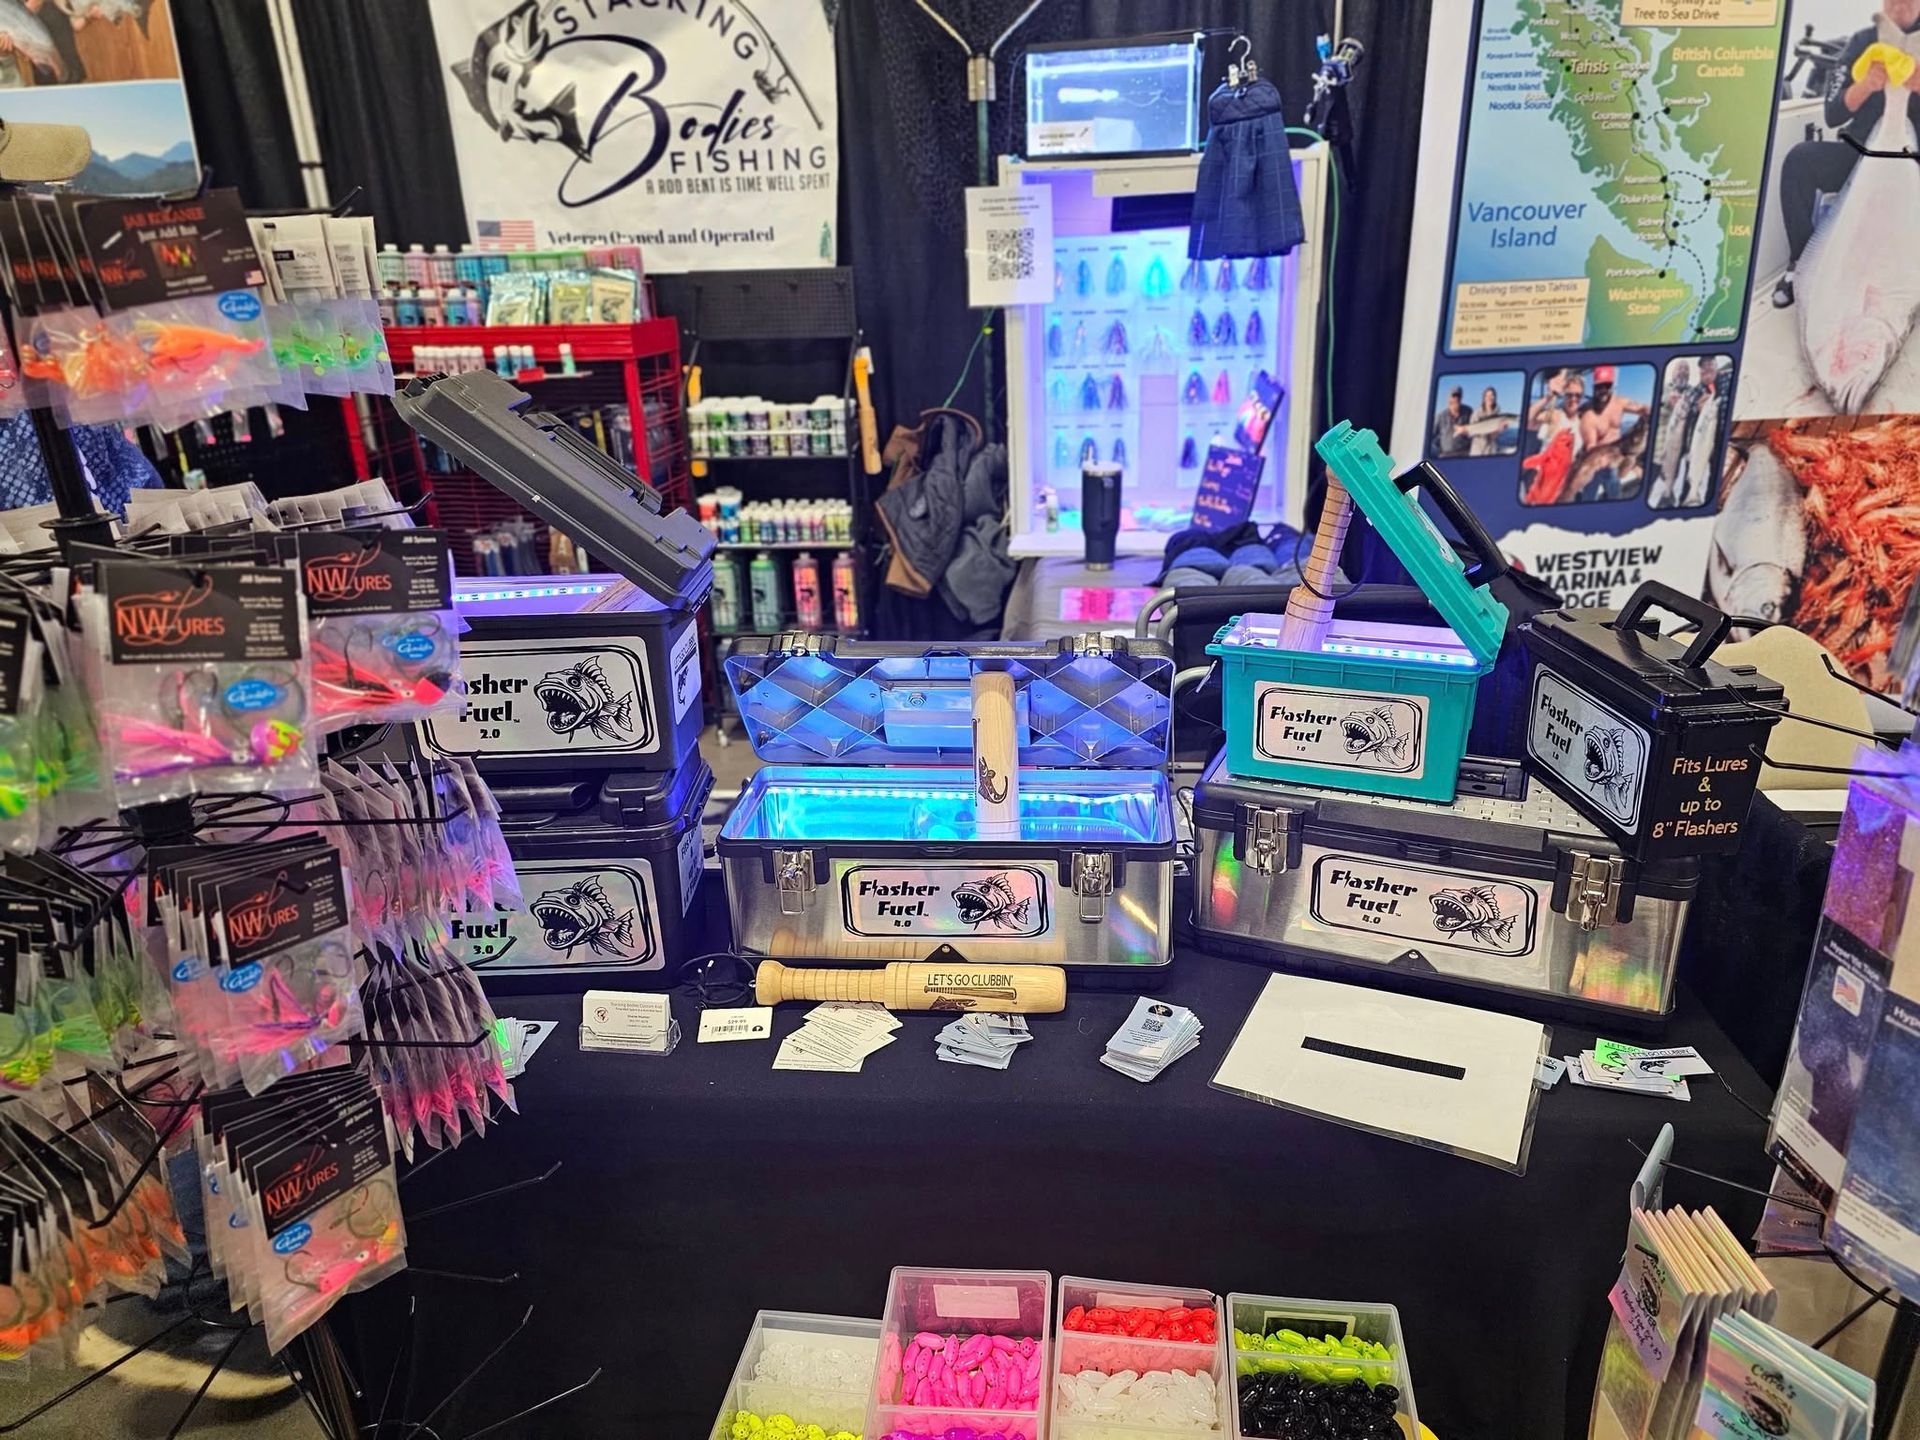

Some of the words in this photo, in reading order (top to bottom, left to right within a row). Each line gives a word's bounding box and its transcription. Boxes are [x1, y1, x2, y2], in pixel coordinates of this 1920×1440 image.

[1634, 8, 1656, 20] Tree
[1658, 9, 1669, 20] to
[1671, 8, 1689, 20] Sea
[1692, 8, 1720, 20] Drive
[1672, 47, 1711, 61] British
[1714, 46, 1775, 60] Columbia
[1481, 70, 1523, 81] Esperanza
[1572, 59, 1610, 75] Tahsis
[1696, 63, 1745, 78] Canada
[1488, 100, 1522, 111] Nootka
[1524, 100, 1552, 110] Sound
[558, 34, 774, 208] Bodies
[670, 146, 827, 174] FISHING
[646, 179, 654, 195] A
[658, 178, 683, 195] ROD
[686, 177, 716, 194] BENT
[720, 177, 732, 193] IS
[736, 175, 763, 193] TIME
[766, 174, 795, 192] WELL
[799, 172, 831, 190] SPENT
[1467, 200, 1587, 223] Vancouver
[668, 228, 698, 244] and
[701, 226, 775, 247] Operated
[1491, 224, 1558, 250] Island
[1729, 225, 1751, 237] USA
[1469, 286, 1507, 298] Driving
[1509, 284, 1533, 294] time
[1535, 284, 1546, 292] to
[1608, 287, 1684, 302] Washington
[1627, 303, 1660, 316] State
[1536, 545, 1663, 573] WESTVIEW
[307, 567, 348, 594] NW
[1630, 568, 1641, 584] &
[1564, 590, 1611, 610] DGE
[116, 607, 169, 637] NW
[460, 700, 513, 723] Fuel
[1270, 706, 1338, 726] Flasher
[480, 728, 501, 739] 2.0
[1283, 726, 1323, 743] Fuel
[1545, 722, 1572, 755] Fuel
[1671, 757, 1701, 776] Fits
[1704, 755, 1748, 774] Lures
[1697, 776, 1712, 793] &
[1679, 801, 1699, 816] up
[1704, 798, 1722, 812] to
[1674, 819, 1739, 838] Flashers
[859, 879, 941, 898] Flasher
[1329, 869, 1418, 898] Flasher
[878, 900, 925, 916] Fuel
[1346, 892, 1397, 916] Fuel
[228, 908, 263, 943] NW
[451, 918, 508, 939] Fuel
[473, 944, 494, 955] 3.0
[927, 973, 954, 986] LET'S
[954, 974, 970, 986] GO
[971, 974, 1014, 987] CLUBBIN'
[265, 1178, 301, 1216] NW
